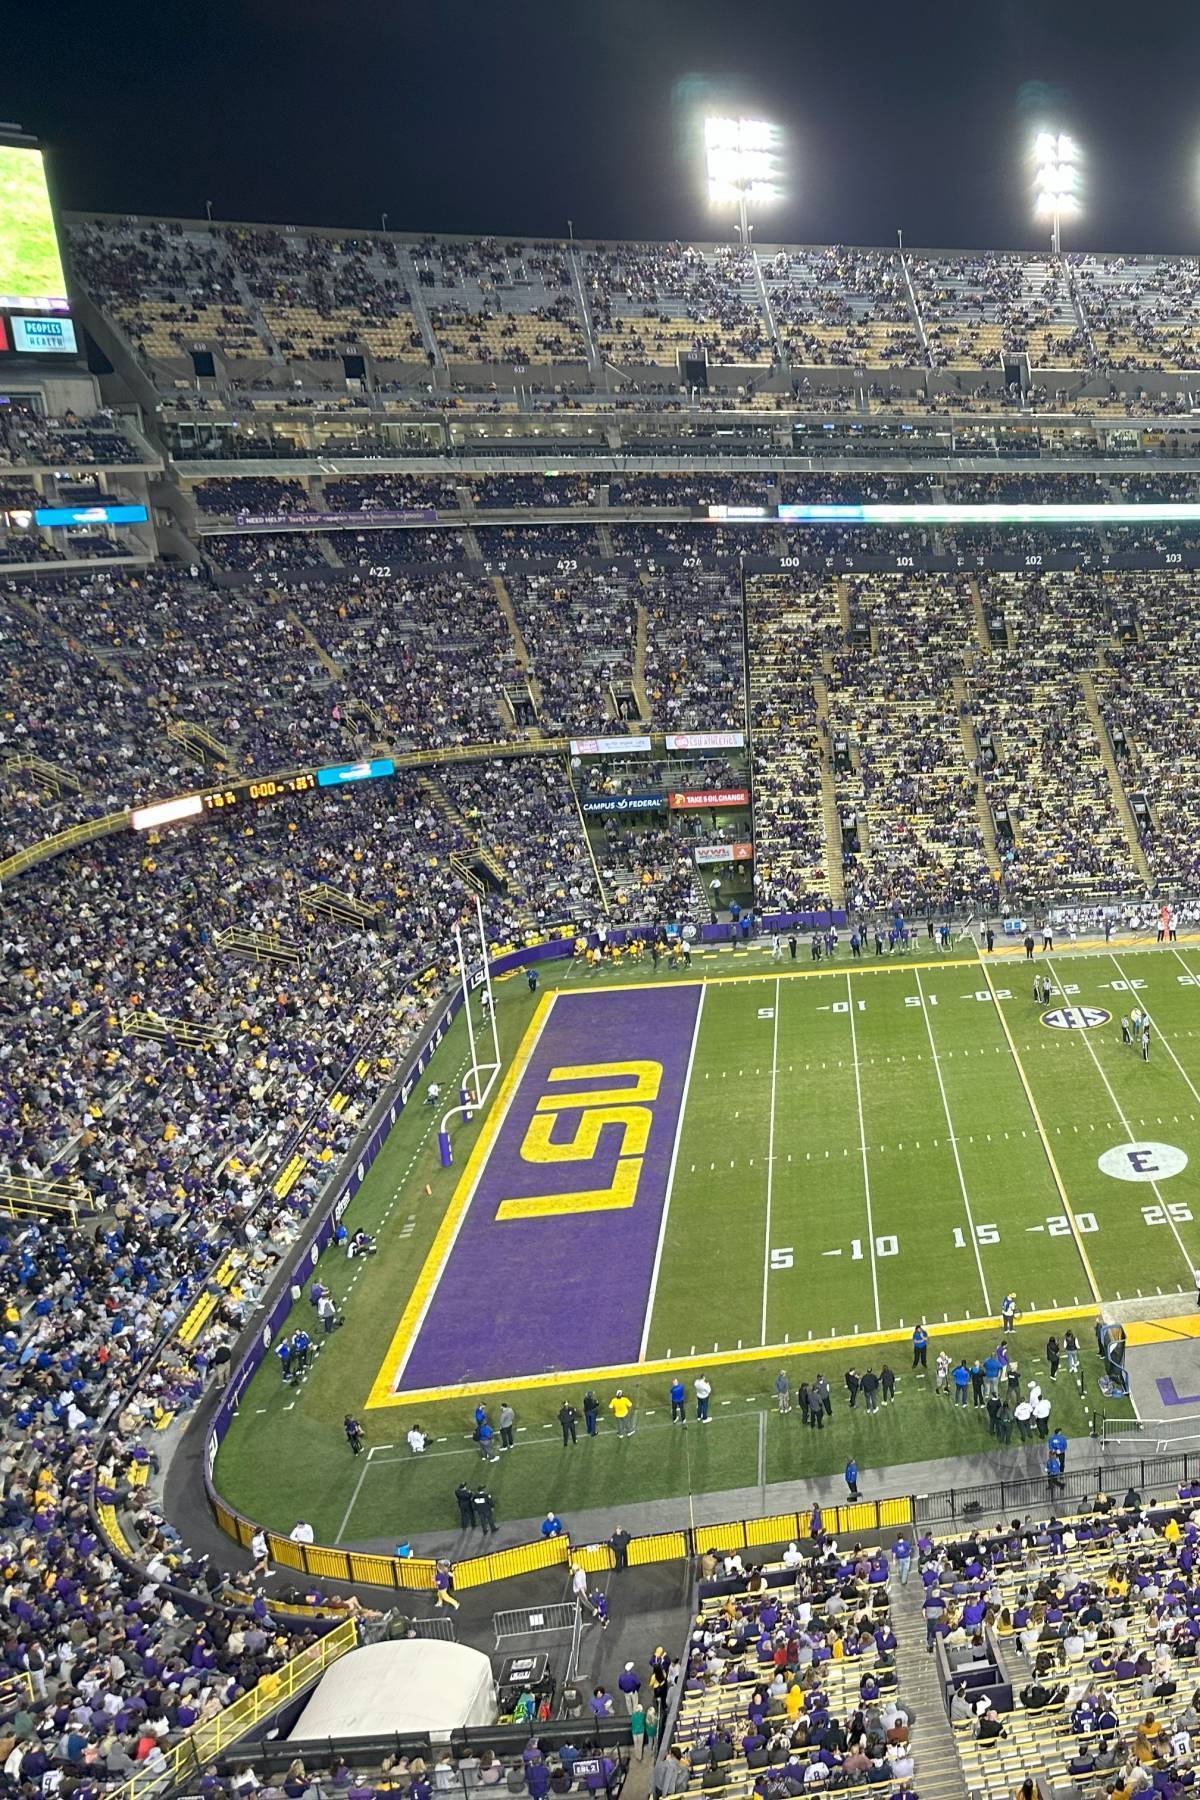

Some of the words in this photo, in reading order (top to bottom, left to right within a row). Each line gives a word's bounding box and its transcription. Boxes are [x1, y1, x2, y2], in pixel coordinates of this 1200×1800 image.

[26, 322, 61, 334] PEOPLES
[29, 336, 64, 347] HEALTH
[780, 557, 800, 567] 100
[896, 557, 914, 567] 101
[1025, 556, 1042, 566] 102
[1166, 553, 1182, 563] 103
[557, 560, 577, 570] 423
[369, 566, 391, 577] 422
[250, 782, 276, 799] 0:00
[583, 802, 615, 810] CAMPUS
[629, 799, 661, 808] FEDERAL
[687, 796, 703, 804] TAKE
[718, 793, 745, 802] CHANGE
[470, 967, 489, 990] LSU
[1111, 979, 1148, 991] 30
[905, 994, 939, 1008] 15
[975, 989, 1011, 1001] 20
[757, 1007, 774, 1019] 5
[832, 1000, 868, 1014] 10
[1044, 1007, 1108, 1029] SEC
[494, 1060, 665, 1222] LSU
[1141, 1202, 1193, 1226] 25
[1046, 1213, 1099, 1236] 20
[953, 1224, 1000, 1248] 15
[851, 1235, 899, 1260] 10
[770, 1248, 793, 1269] 5
[1179, 1743, 1187, 1755] 9
[576, 1765, 590, 1773] EBL
